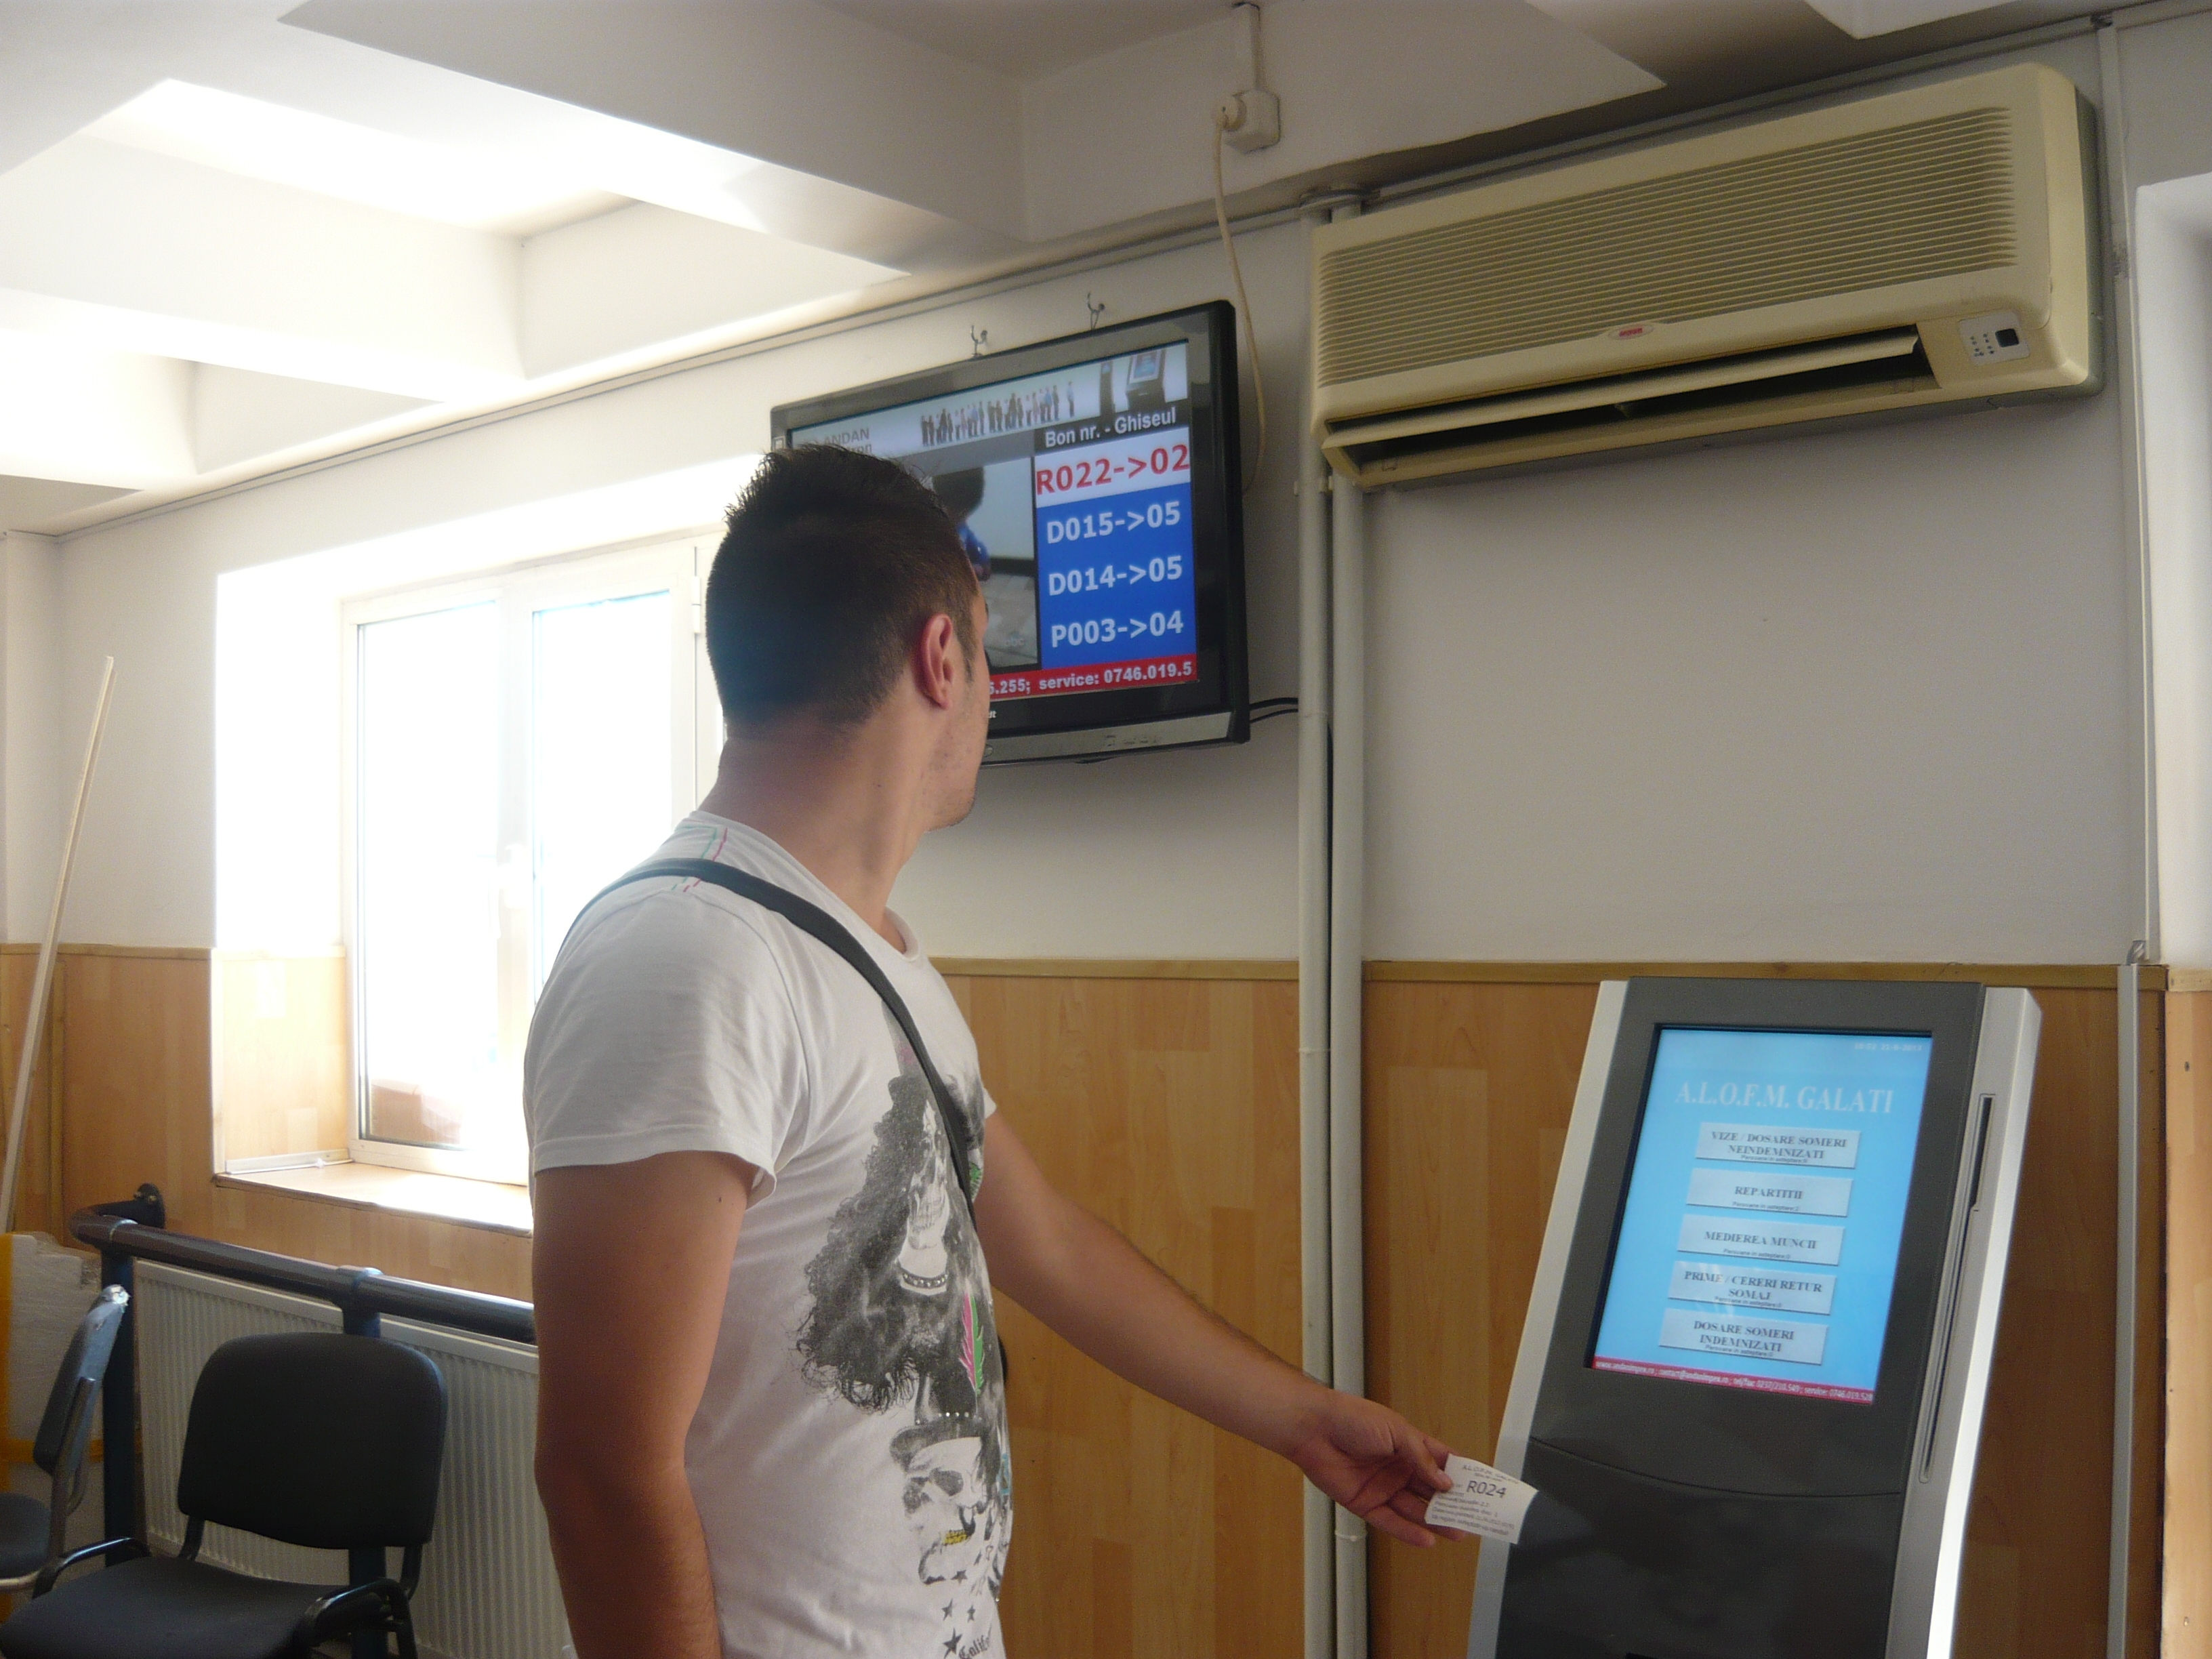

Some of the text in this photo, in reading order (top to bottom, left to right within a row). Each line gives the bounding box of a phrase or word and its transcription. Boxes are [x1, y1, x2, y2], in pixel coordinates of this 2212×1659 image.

[1045, 430, 1076, 448] Bon
[1080, 425, 1100, 441] nr.
[1114, 407, 1176, 434] Ghiseul
[1036, 444, 1191, 495] R022->02
[1047, 501, 1181, 544] D015->05
[1048, 555, 1183, 596] D014->05
[1051, 610, 1184, 648] P003->04
[1039, 674, 1099, 690] service:
[1103, 661, 1192, 684] 0746.019.5
[1675, 1081, 1894, 1113] A.L.O.F.M. GALATI
[1711, 1131, 1738, 1141] VIZE
[1747, 1134, 1795, 1145] DOSARE
[1798, 1136, 1847, 1147] SOMERI
[1728, 1145, 1824, 1159] NEINDEMNIZATI
[1735, 1187, 1803, 1199] REPARTITII
[1704, 1231, 1818, 1249] MEDIEREA MUNCII
[1684, 1271, 1723, 1283] PRIME
[1732, 1275, 1778, 1288] CERERI
[1780, 1280, 1822, 1292] RETUR
[1729, 1288, 1772, 1300] SOMAJ
[1694, 1321, 1795, 1340] DOSARE SOMERI
[1700, 1334, 1783, 1352] INDEMNIZATI
[1466, 1480, 1507, 1498] R024
